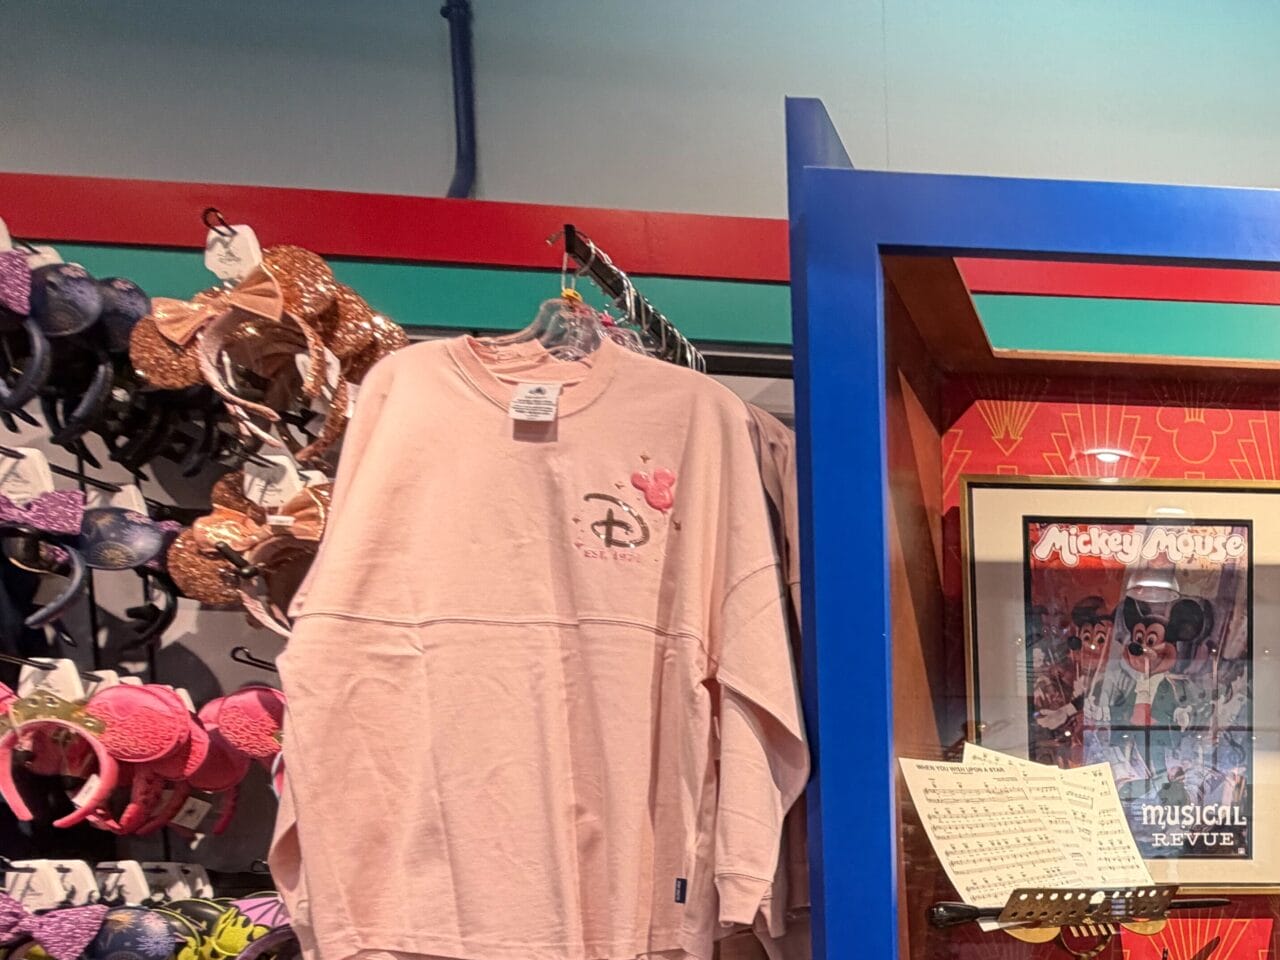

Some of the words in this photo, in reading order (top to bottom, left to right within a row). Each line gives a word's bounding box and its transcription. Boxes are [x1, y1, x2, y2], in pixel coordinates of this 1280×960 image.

[1033, 525, 1142, 566] Mickey
[1141, 527, 1246, 562] Mouse
[1141, 803, 1247, 829] MUSICAL
[1151, 832, 1235, 847] REVUE
